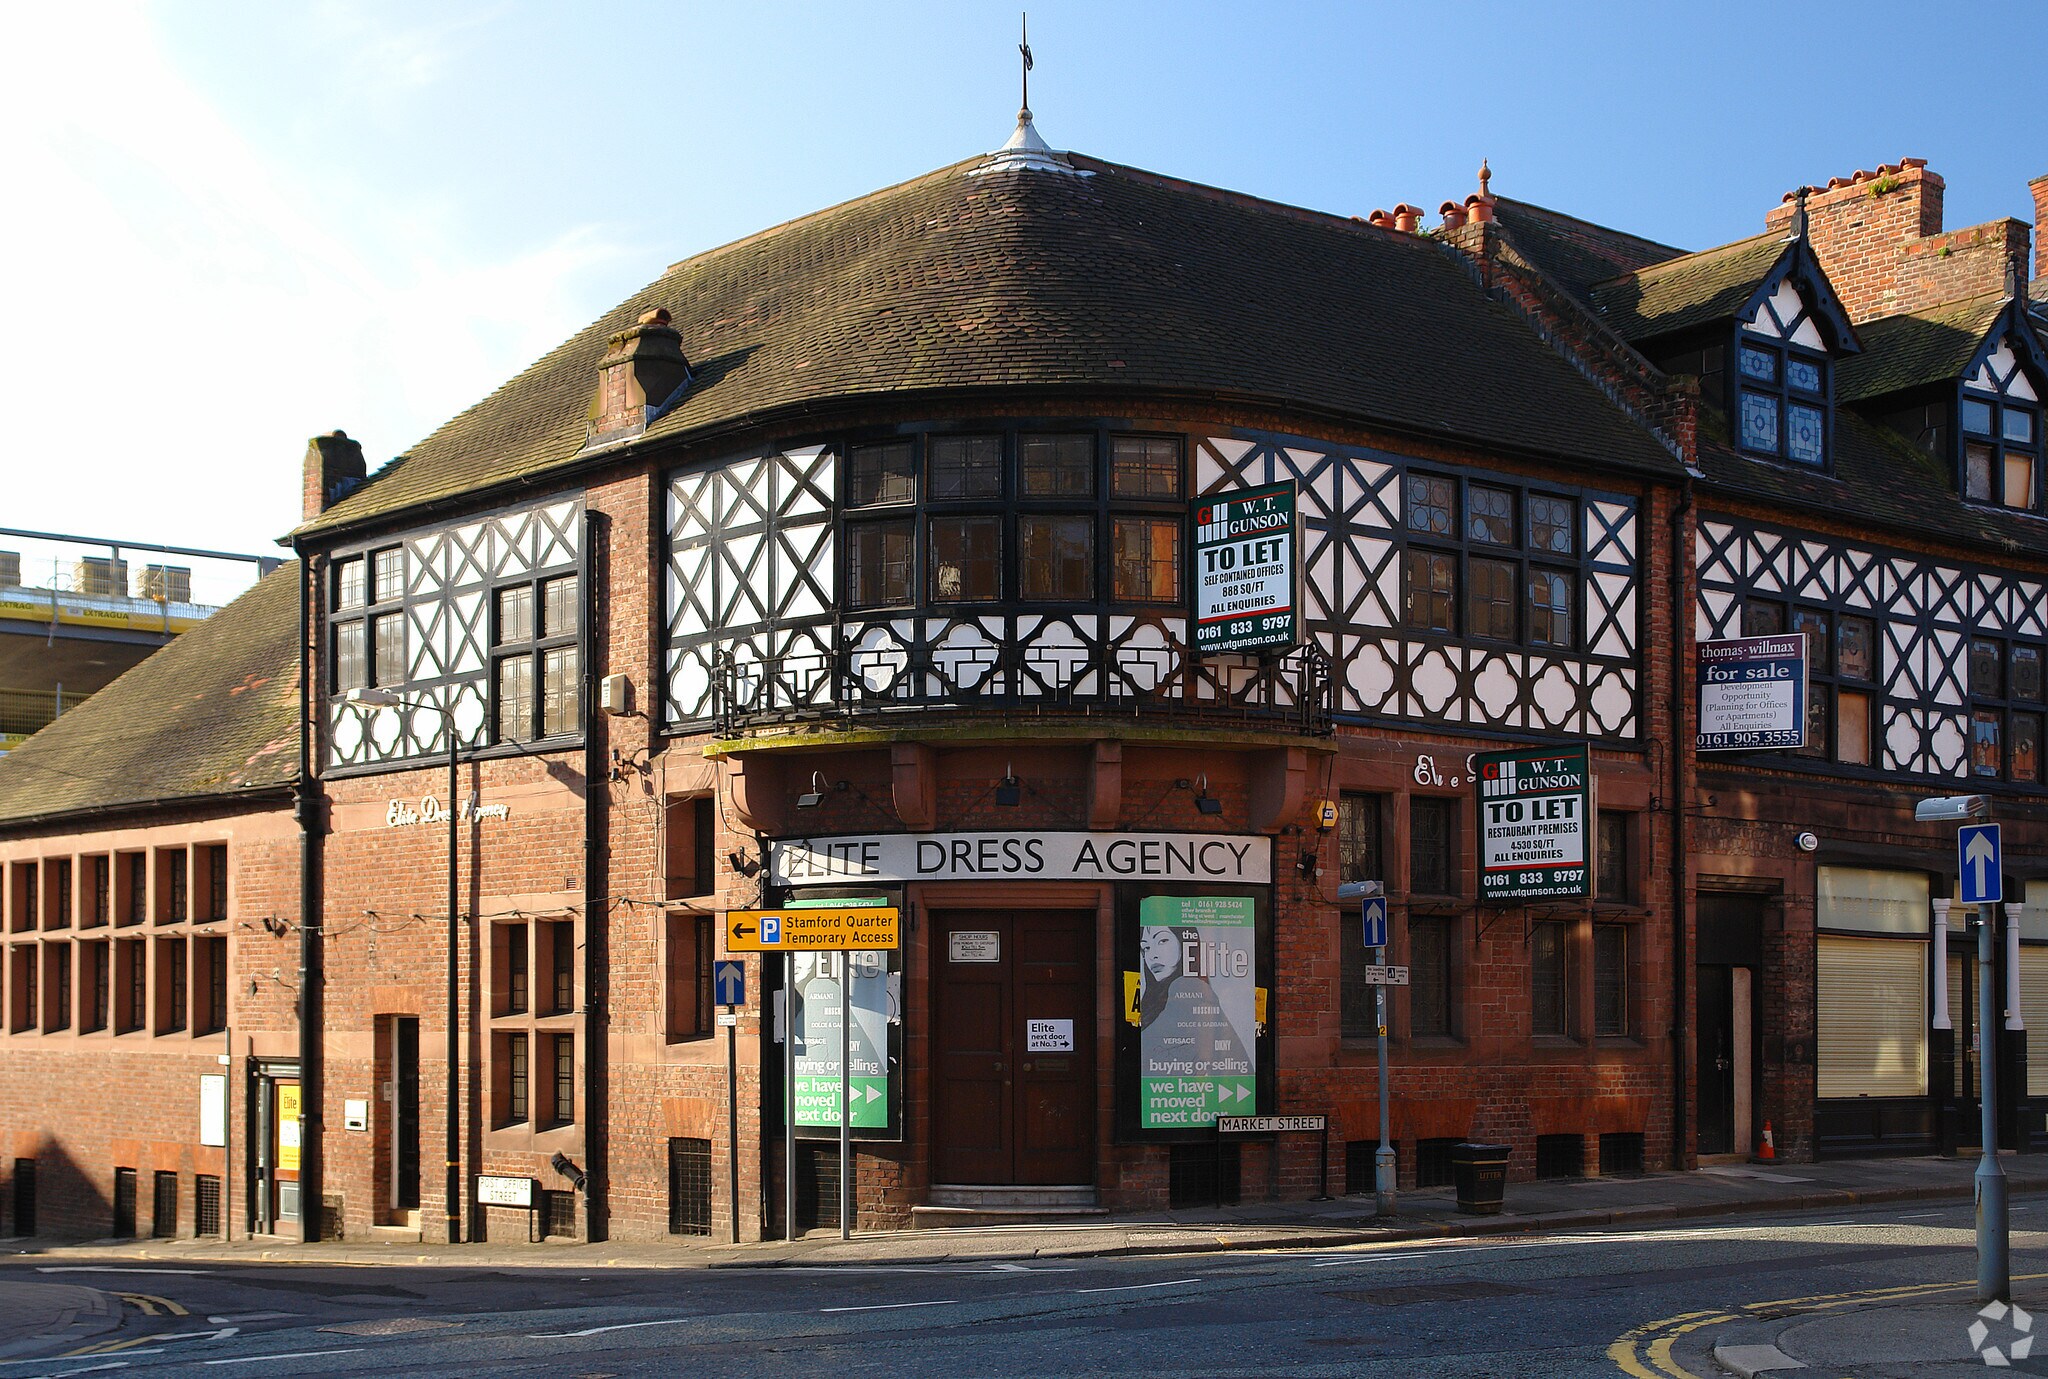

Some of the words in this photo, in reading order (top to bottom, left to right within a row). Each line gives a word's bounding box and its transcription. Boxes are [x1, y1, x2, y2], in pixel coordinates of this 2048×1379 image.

[1242, 501, 1259, 515] W.
[1264, 497, 1276, 511] T.
[1229, 512, 1289, 534] GUNSON
[1204, 546, 1236, 573] TO
[1242, 538, 1284, 567] LET
[1204, 574, 1219, 587] SELF
[1219, 569, 1256, 584] CONTAINED
[1257, 563, 1284, 578] OFFICES
[1222, 586, 1238, 597] 888
[1240, 581, 1264, 595] SQ/FT
[1210, 603, 1225, 614] ALL
[1227, 595, 1275, 611] ENQUIRIES
[1197, 626, 1222, 640] 0161
[1230, 621, 1253, 635] 833
[1262, 615, 1291, 631] 9797
[1200, 632, 1289, 652] www.wtgunson.co.uk
[1706, 665, 1738, 681] for
[1746, 662, 1790, 679] sale
[1720, 682, 1773, 693] Development
[1721, 691, 1771, 702] Opportunity
[1705, 702, 1744, 712] (Planning
[1746, 702, 1758, 710] for
[1759, 700, 1788, 708] Offices
[1726, 711, 1777, 721] Apartments)
[1720, 723, 1731, 731] All
[1733, 721, 1772, 731] Enquiries
[1696, 733, 1729, 745] 0161
[1734, 732, 1760, 744] 905
[1764, 730, 1799, 743] 3555
[1531, 761, 1549, 774] W.
[1554, 759, 1567, 771] T.
[1518, 773, 1581, 791] GUNSON
[386, 799, 420, 827] Elite
[1488, 802, 1524, 823] TO
[1532, 798, 1578, 820] LET
[1488, 824, 1536, 839] RESTAURANT
[1538, 822, 1578, 836] PREMISES
[1533, 838, 1555, 850] SQ/FT
[788, 840, 881, 877] ELITE
[916, 838, 1044, 874] DRESS
[1072, 838, 1252, 876] AGENCY
[1494, 852, 1510, 862] ALL
[1512, 849, 1563, 861] ENQUIRIES
[1483, 874, 1510, 886] 0161
[1519, 872, 1544, 884] 833
[1554, 869, 1584, 883] 9797
[1487, 884, 1582, 898] www.wtgunson.co.uk
[786, 916, 840, 928] Stamford
[846, 915, 893, 928] Quarter
[785, 932, 846, 945] Temporary
[852, 931, 894, 943] Access
[1182, 930, 1198, 939] the
[815, 950, 879, 979] Elte
[1182, 941, 1249, 977] Elite
[1031, 1023, 1055, 1033] Elite
[1380, 1026, 1386, 1035] 2
[1163, 1037, 1196, 1045] VERSACE
[1214, 1039, 1231, 1051] DKNY
[795, 1058, 825, 1074] uying
[826, 1061, 840, 1071] or
[849, 1059, 879, 1075] elling
[1149, 1058, 1193, 1075] buying
[1195, 1062, 1208, 1071] or
[1212, 1058, 1248, 1073] selling
[811, 1078, 842, 1092] have
[1150, 1082, 1175, 1093] we
[1178, 1078, 1214, 1093] have
[1150, 1093, 1206, 1108] moved
[822, 1107, 857, 1122] dor
[1150, 1111, 1187, 1123] next
[1222, 1118, 1272, 1131] MARKET
[1278, 1117, 1322, 1130] STREET
[480, 1177, 499, 1188] POST
[503, 1179, 528, 1190] OFFICE
[490, 1190, 518, 1202] STREET
